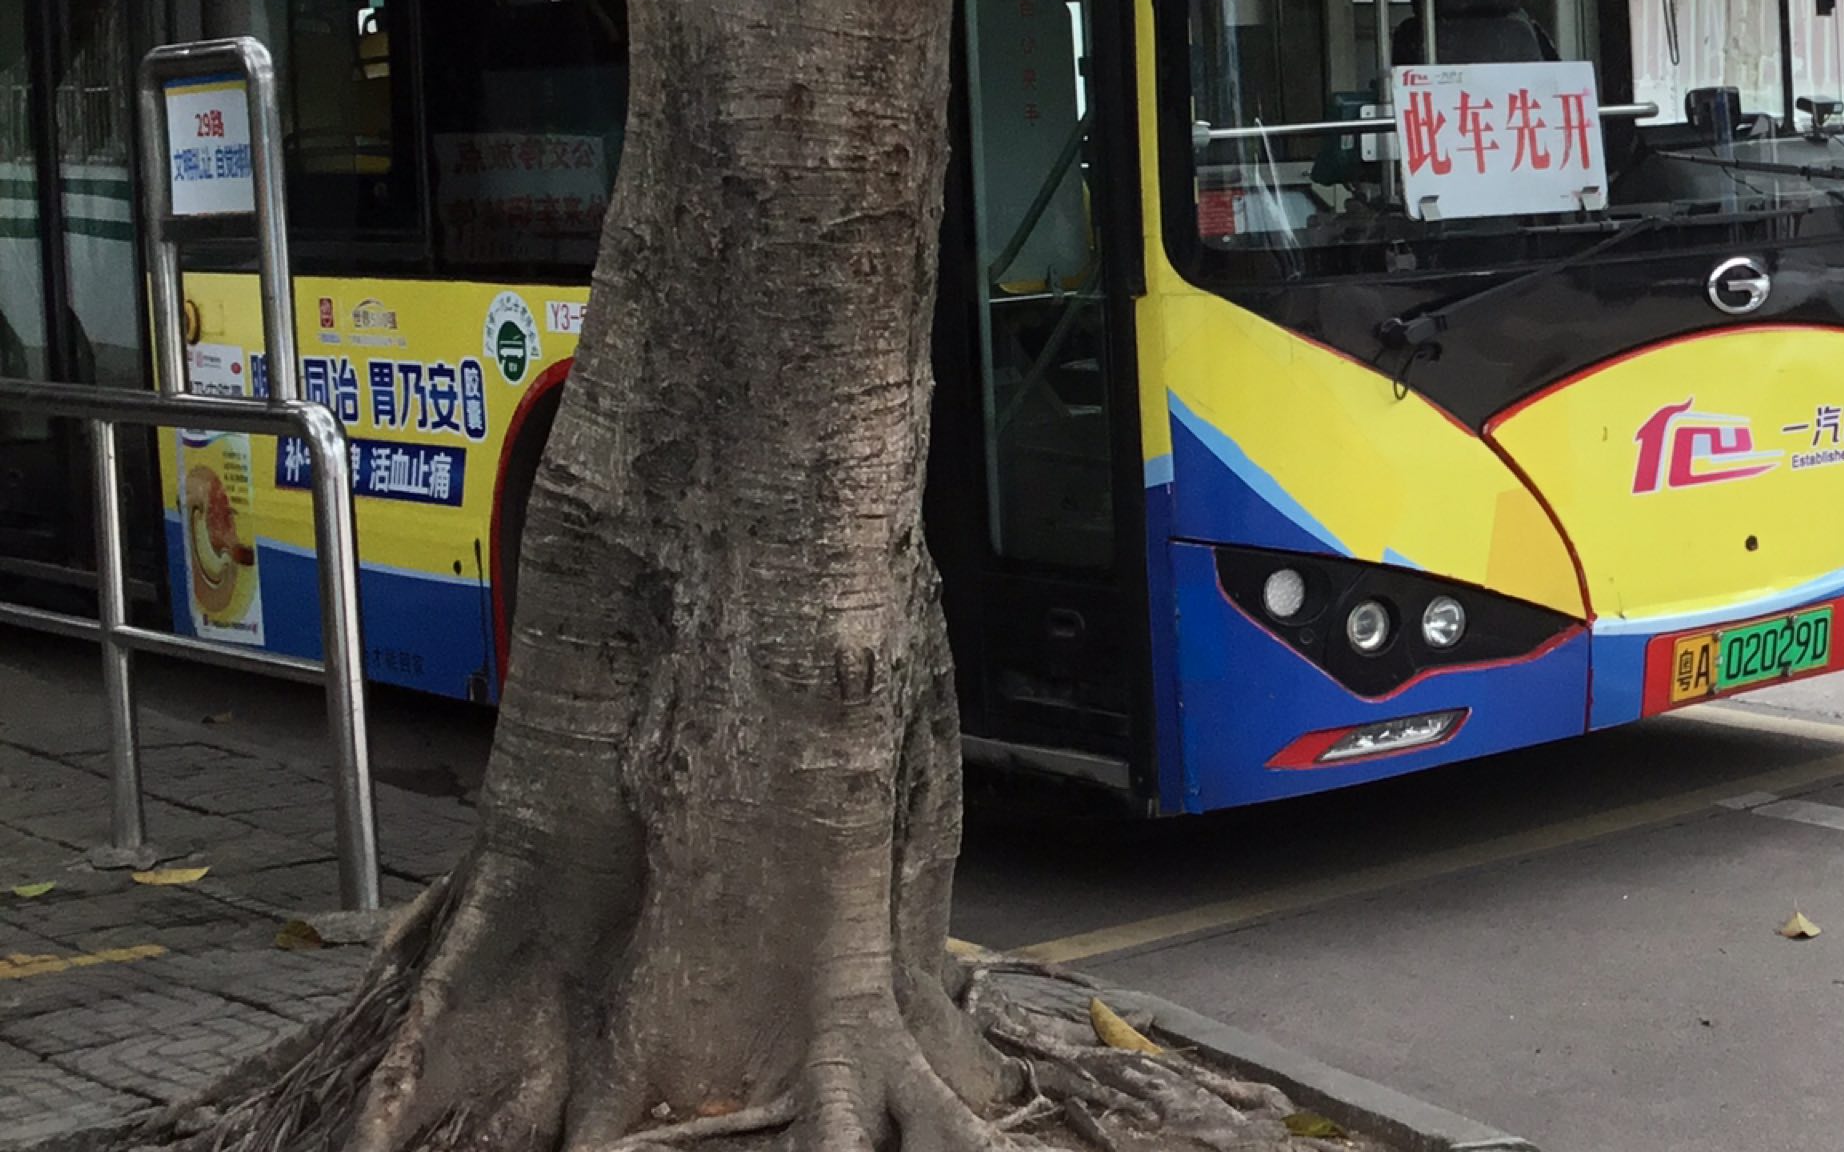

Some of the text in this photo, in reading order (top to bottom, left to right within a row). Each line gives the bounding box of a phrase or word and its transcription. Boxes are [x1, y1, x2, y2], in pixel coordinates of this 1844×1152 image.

[195, 110, 224, 138] 29路
[1403, 88, 1595, 176] 此车先开
[370, 447, 452, 499] 活血止痛
